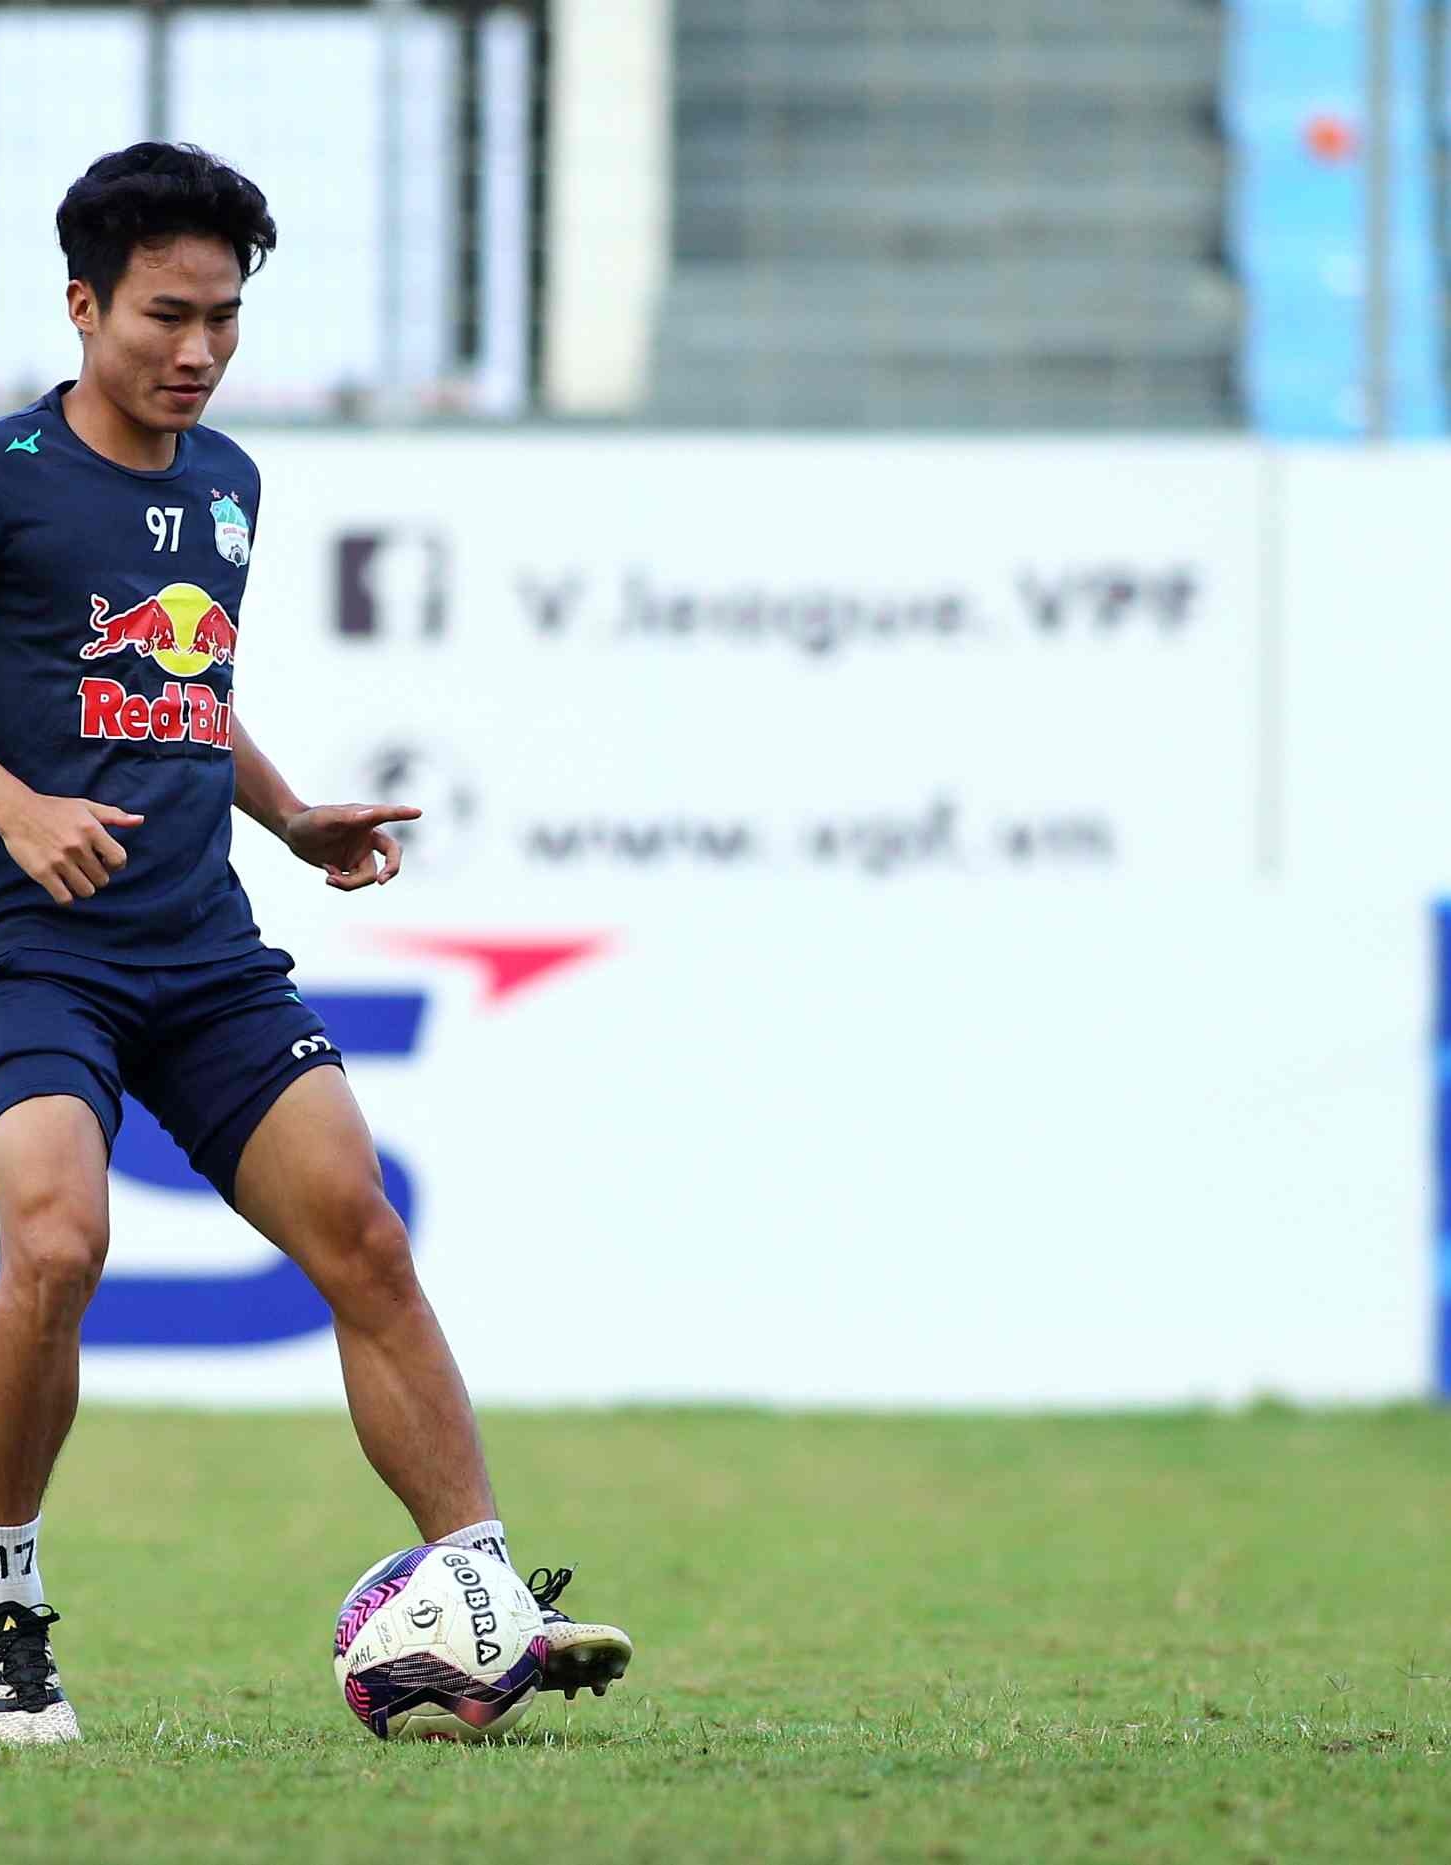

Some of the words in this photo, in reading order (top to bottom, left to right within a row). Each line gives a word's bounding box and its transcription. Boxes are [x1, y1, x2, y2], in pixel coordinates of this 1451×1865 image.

[146, 506, 184, 552] 97
[77, 677, 189, 743] Red
[442, 1553, 502, 1667] COBRA
